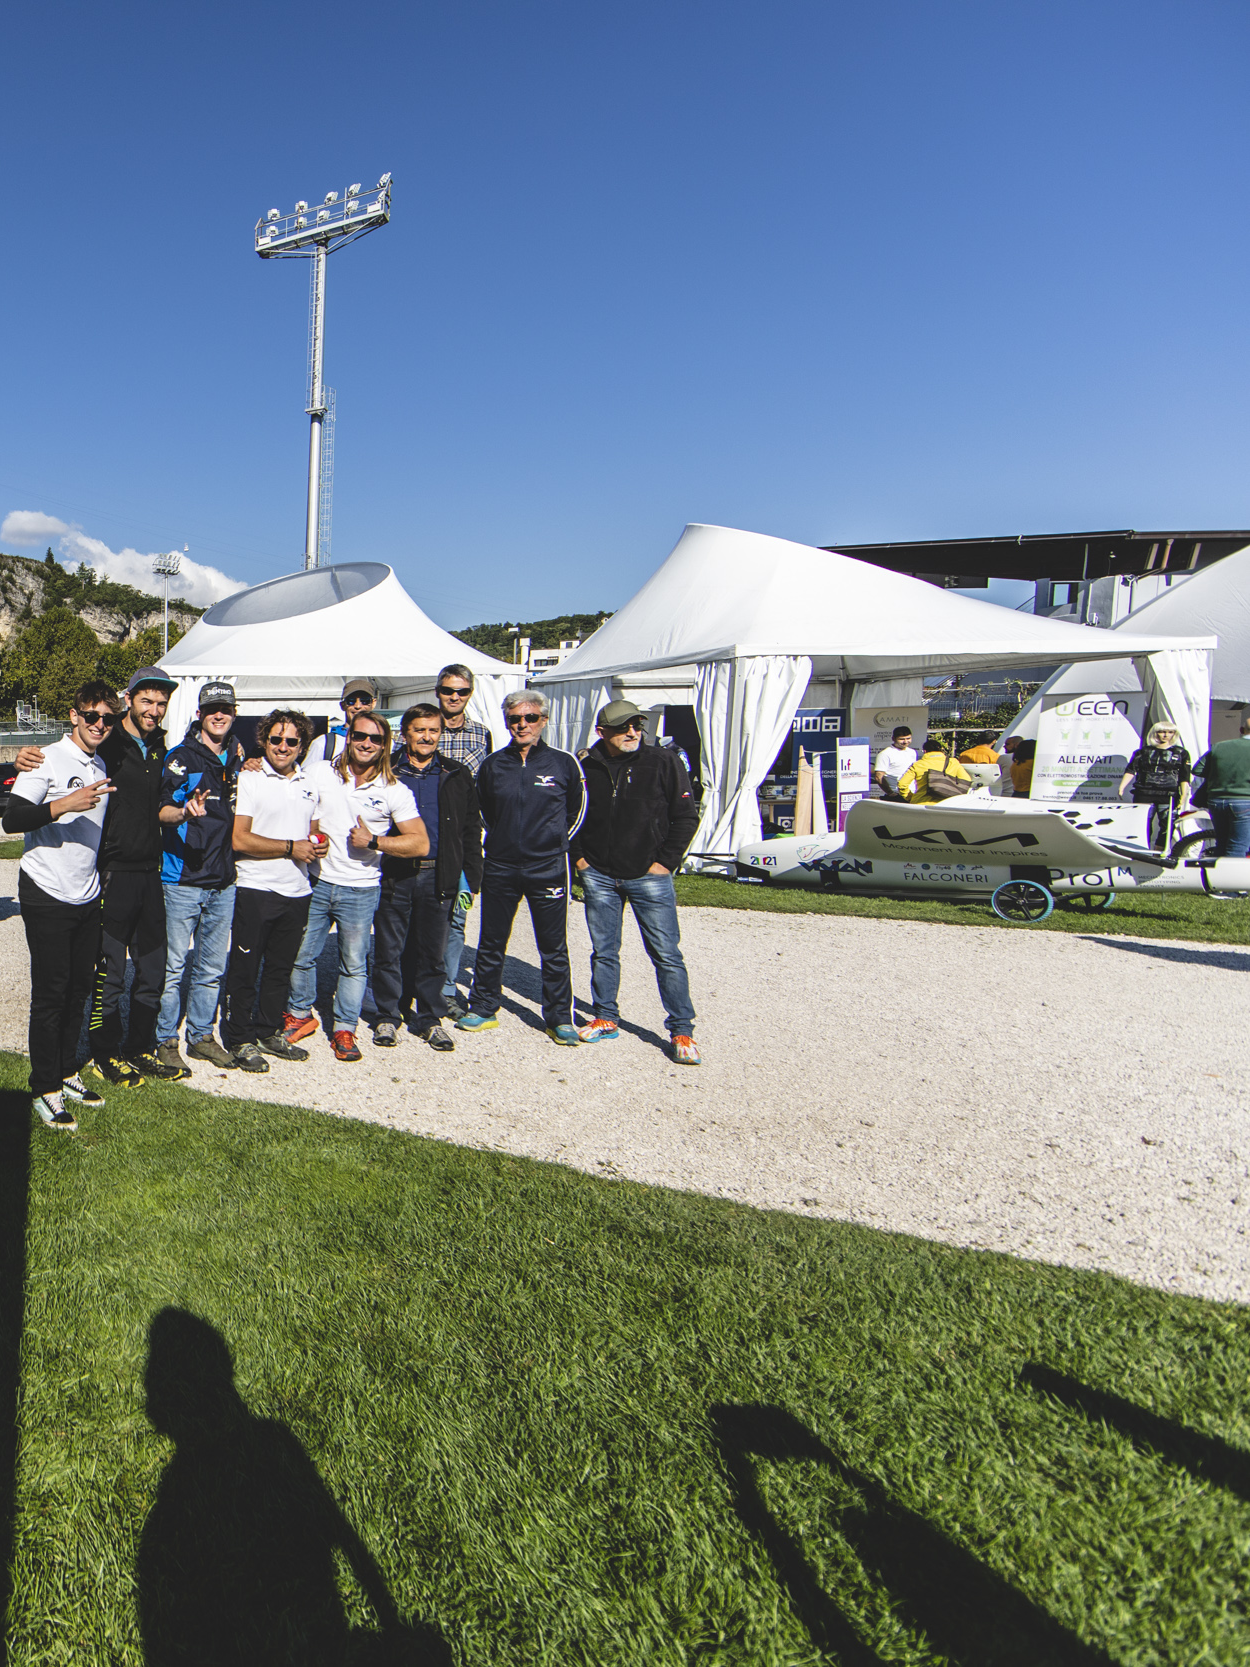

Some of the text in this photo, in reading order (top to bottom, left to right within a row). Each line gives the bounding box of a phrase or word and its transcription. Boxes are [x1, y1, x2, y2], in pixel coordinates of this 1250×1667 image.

[1057, 755, 1112, 764] ALLENATI
[881, 842, 953, 853] Movement
[989, 849, 1048, 857] inspires
[903, 872, 989, 883] FALCONERI
